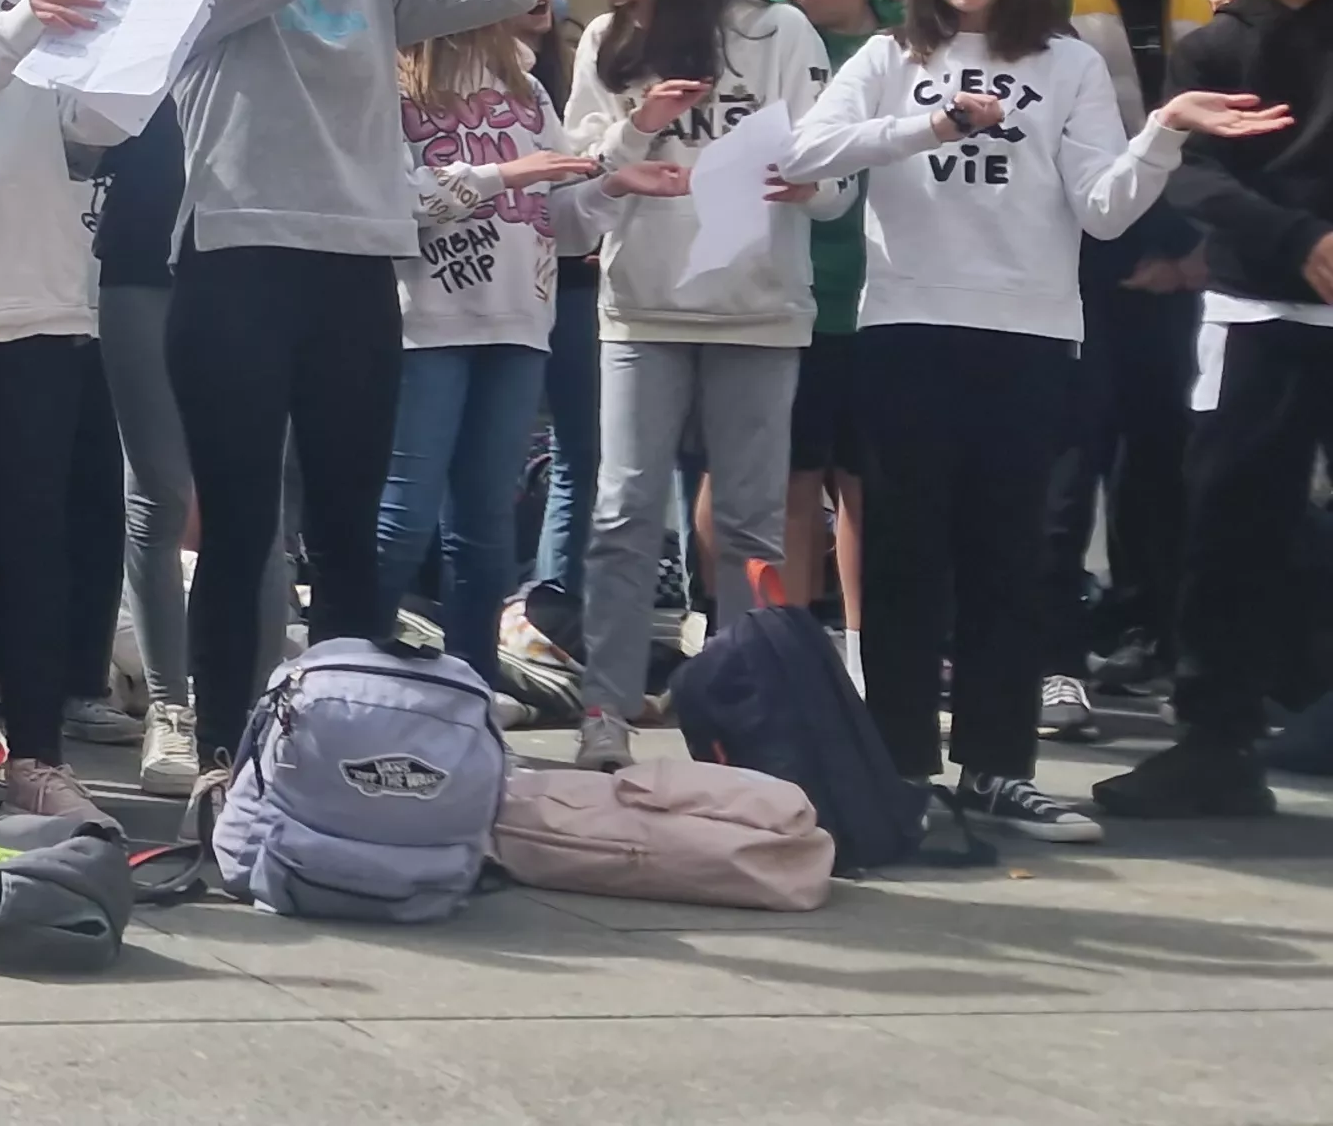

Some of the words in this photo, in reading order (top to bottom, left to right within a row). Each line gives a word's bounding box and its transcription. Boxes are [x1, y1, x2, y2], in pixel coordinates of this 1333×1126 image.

[913, 69, 1043, 111] C'EST
[653, 94, 754, 140] ANS
[421, 220, 500, 265] URBAN
[431, 254, 495, 293] TRIP
